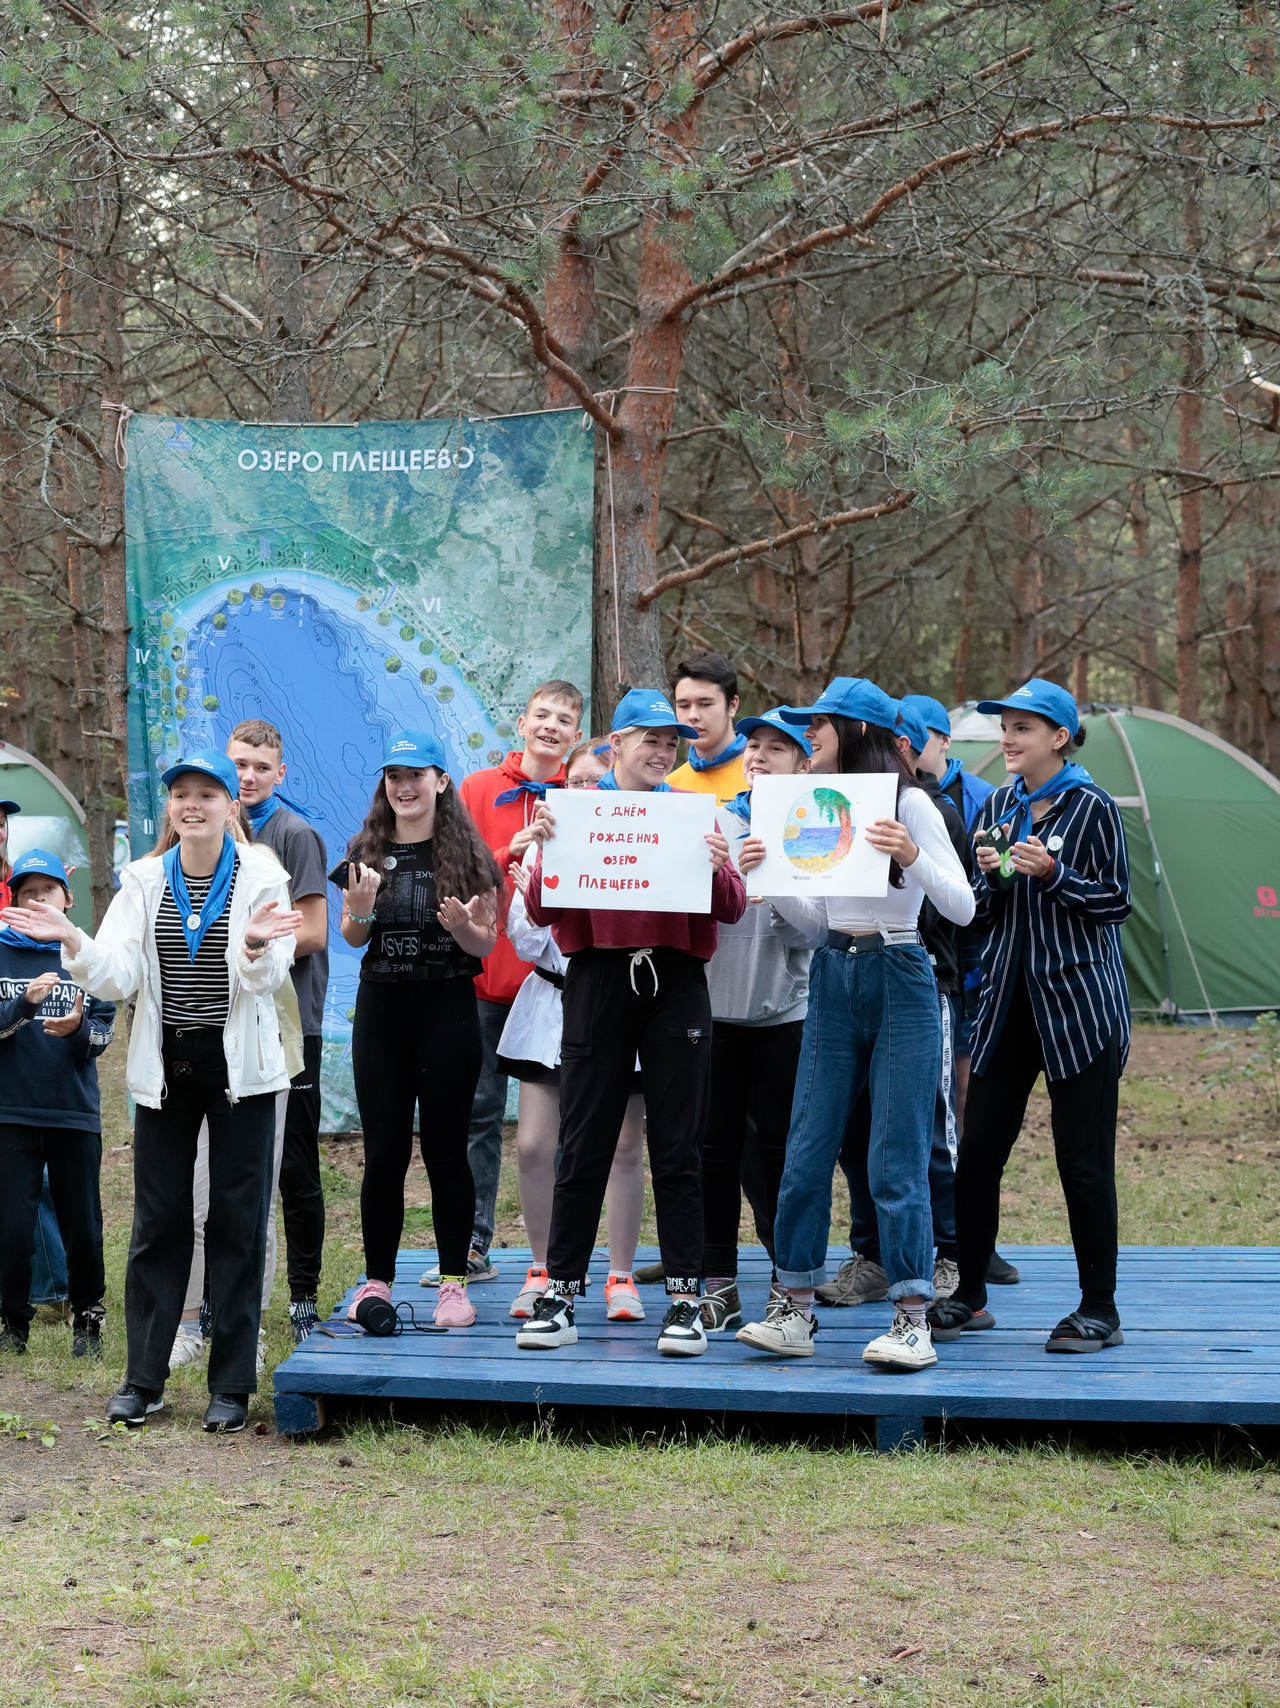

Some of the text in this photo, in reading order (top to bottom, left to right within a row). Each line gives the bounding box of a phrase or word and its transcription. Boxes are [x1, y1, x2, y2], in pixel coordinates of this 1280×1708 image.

[237, 446, 475, 474] ОЗЕРО ПЛЕЩЕЕВО
[217, 555, 234, 572] V
[421, 597, 442, 613] VI
[135, 648, 150, 664] IV
[250, 677, 259, 686] 20
[595, 803, 647, 817] С ДНЁМ
[589, 832, 659, 845] РОЖДЕНИЯ
[603, 855, 638, 866] ОЗЕРО
[41, 1008, 61, 1016] GIVE
[568, 1279, 581, 1289] ON
